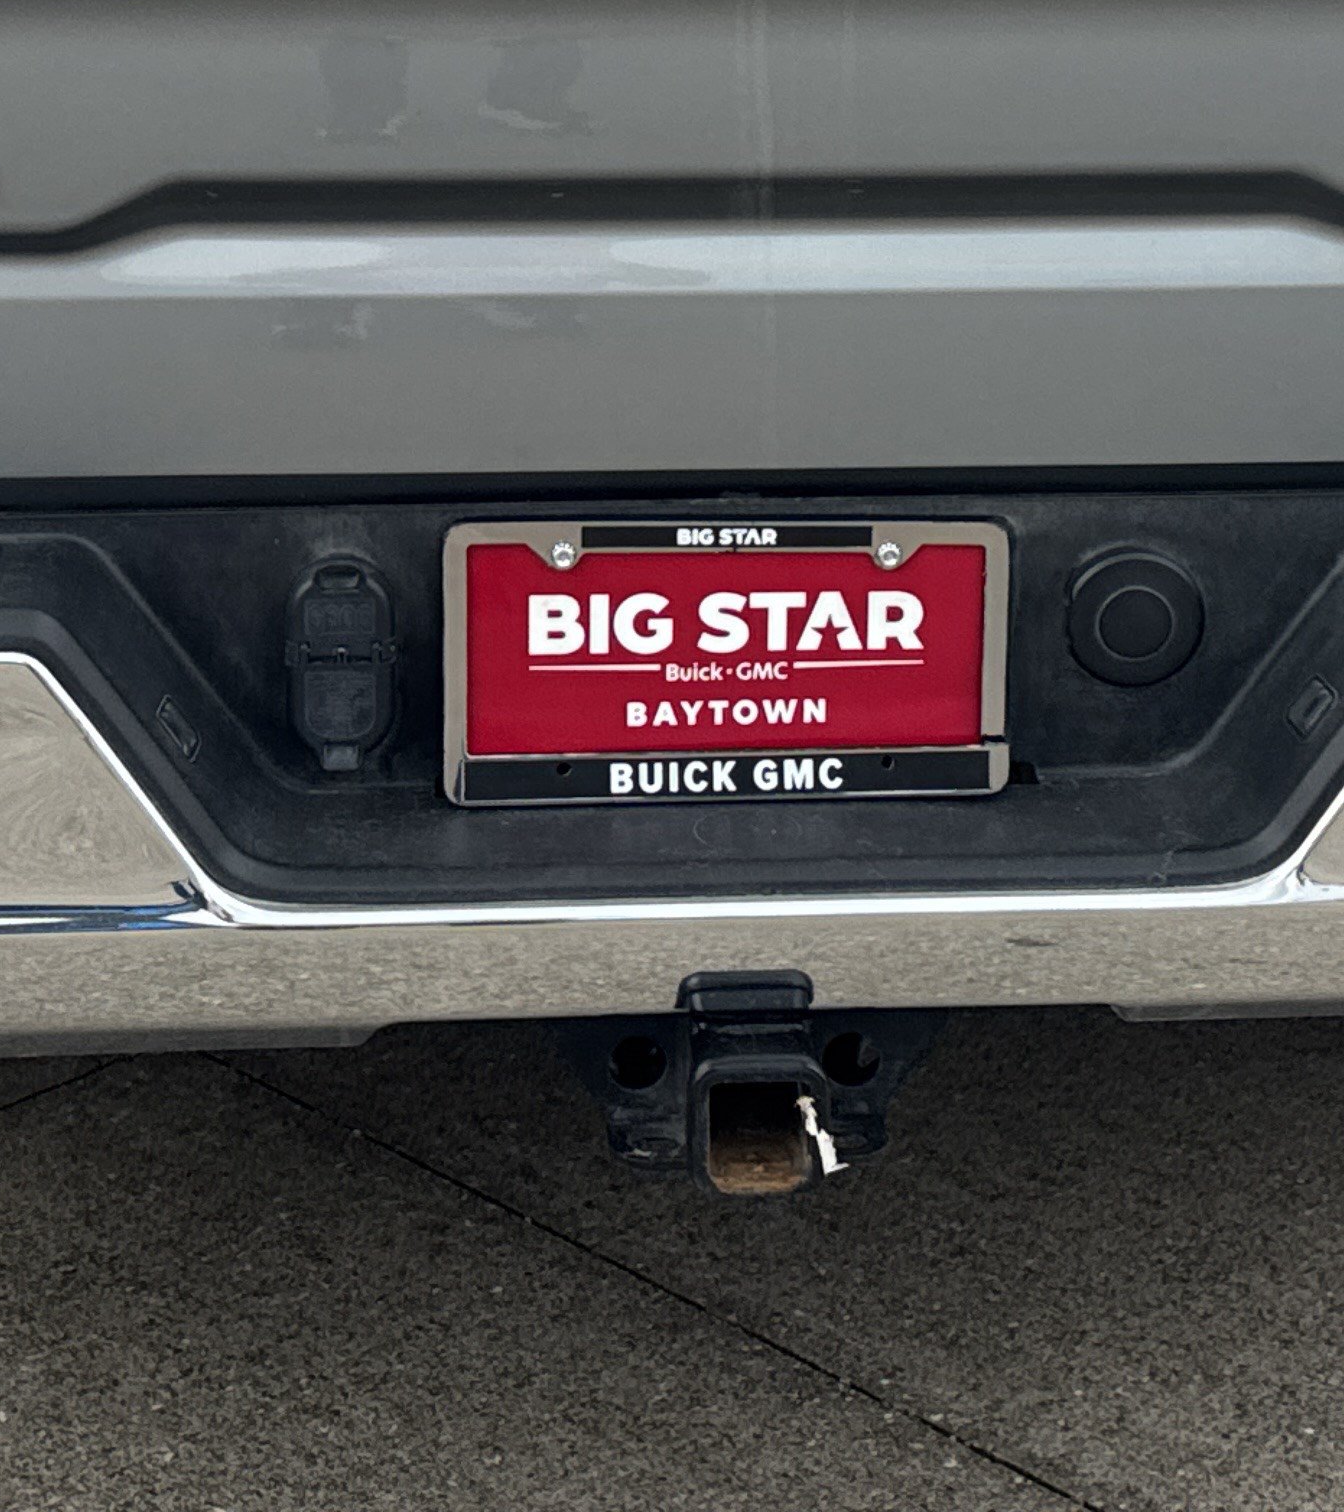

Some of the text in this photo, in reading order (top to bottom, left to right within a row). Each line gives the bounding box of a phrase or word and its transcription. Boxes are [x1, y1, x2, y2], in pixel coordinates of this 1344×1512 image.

[676, 528, 778, 546] BIG STAR
[528, 590, 924, 656] BIG STAR
[665, 660, 789, 683] Buick GMC
[626, 698, 827, 727] BAYTOWN
[609, 757, 844, 794] BUICK GMC
